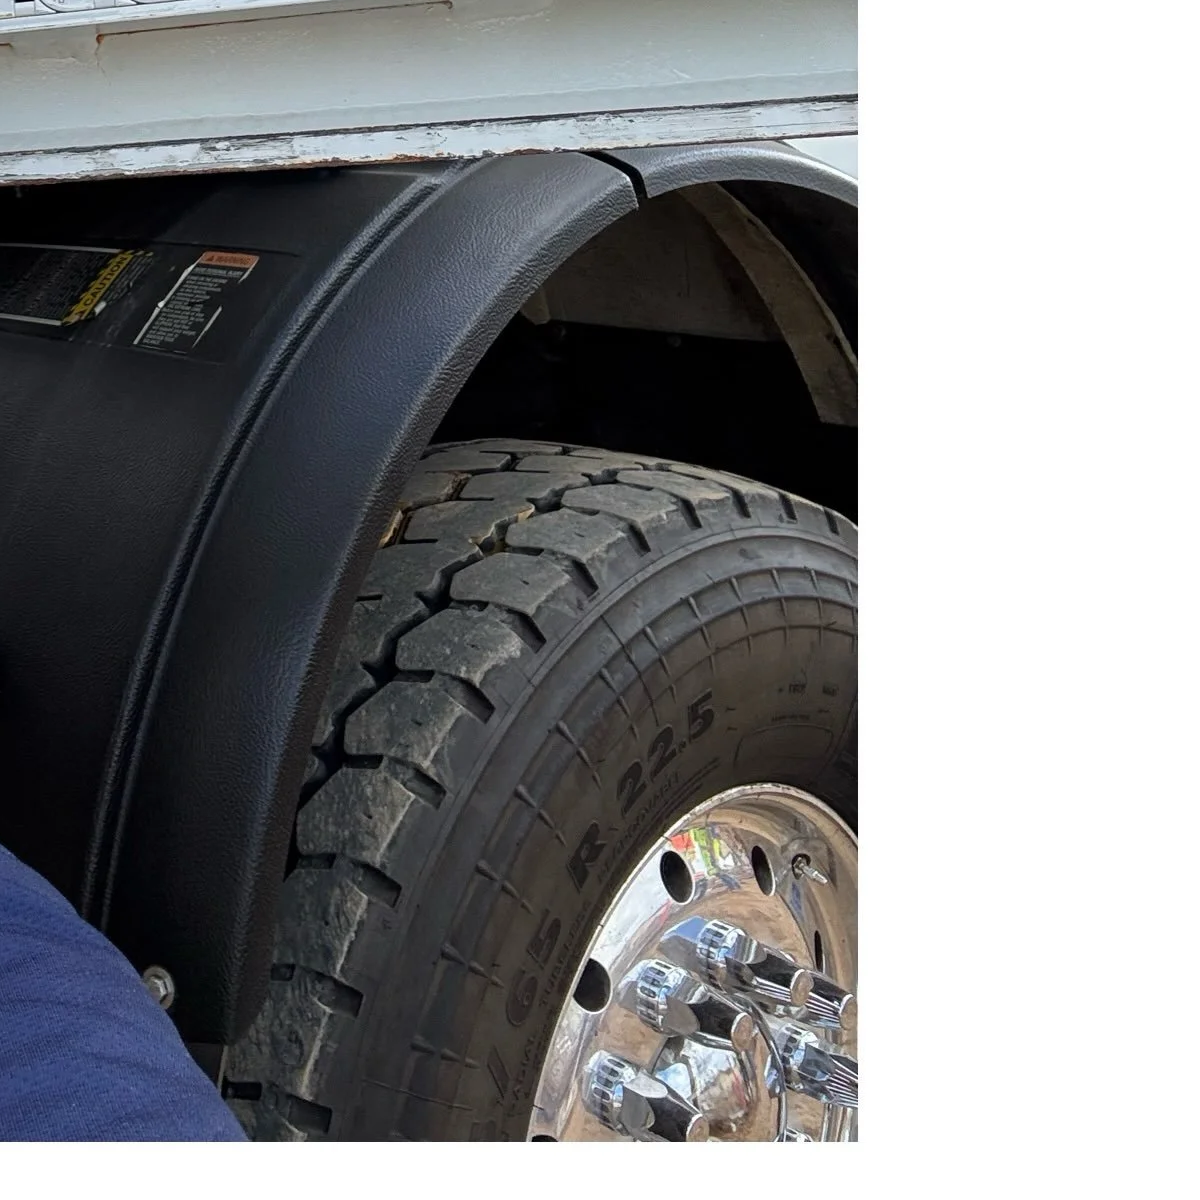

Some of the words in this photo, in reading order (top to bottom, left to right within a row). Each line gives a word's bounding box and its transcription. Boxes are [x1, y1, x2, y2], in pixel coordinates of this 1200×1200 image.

[82, 254, 129, 307] CAUTION
[506, 913, 562, 1027] 65
[564, 821, 610, 893] R
[616, 689, 716, 813] 22.5
